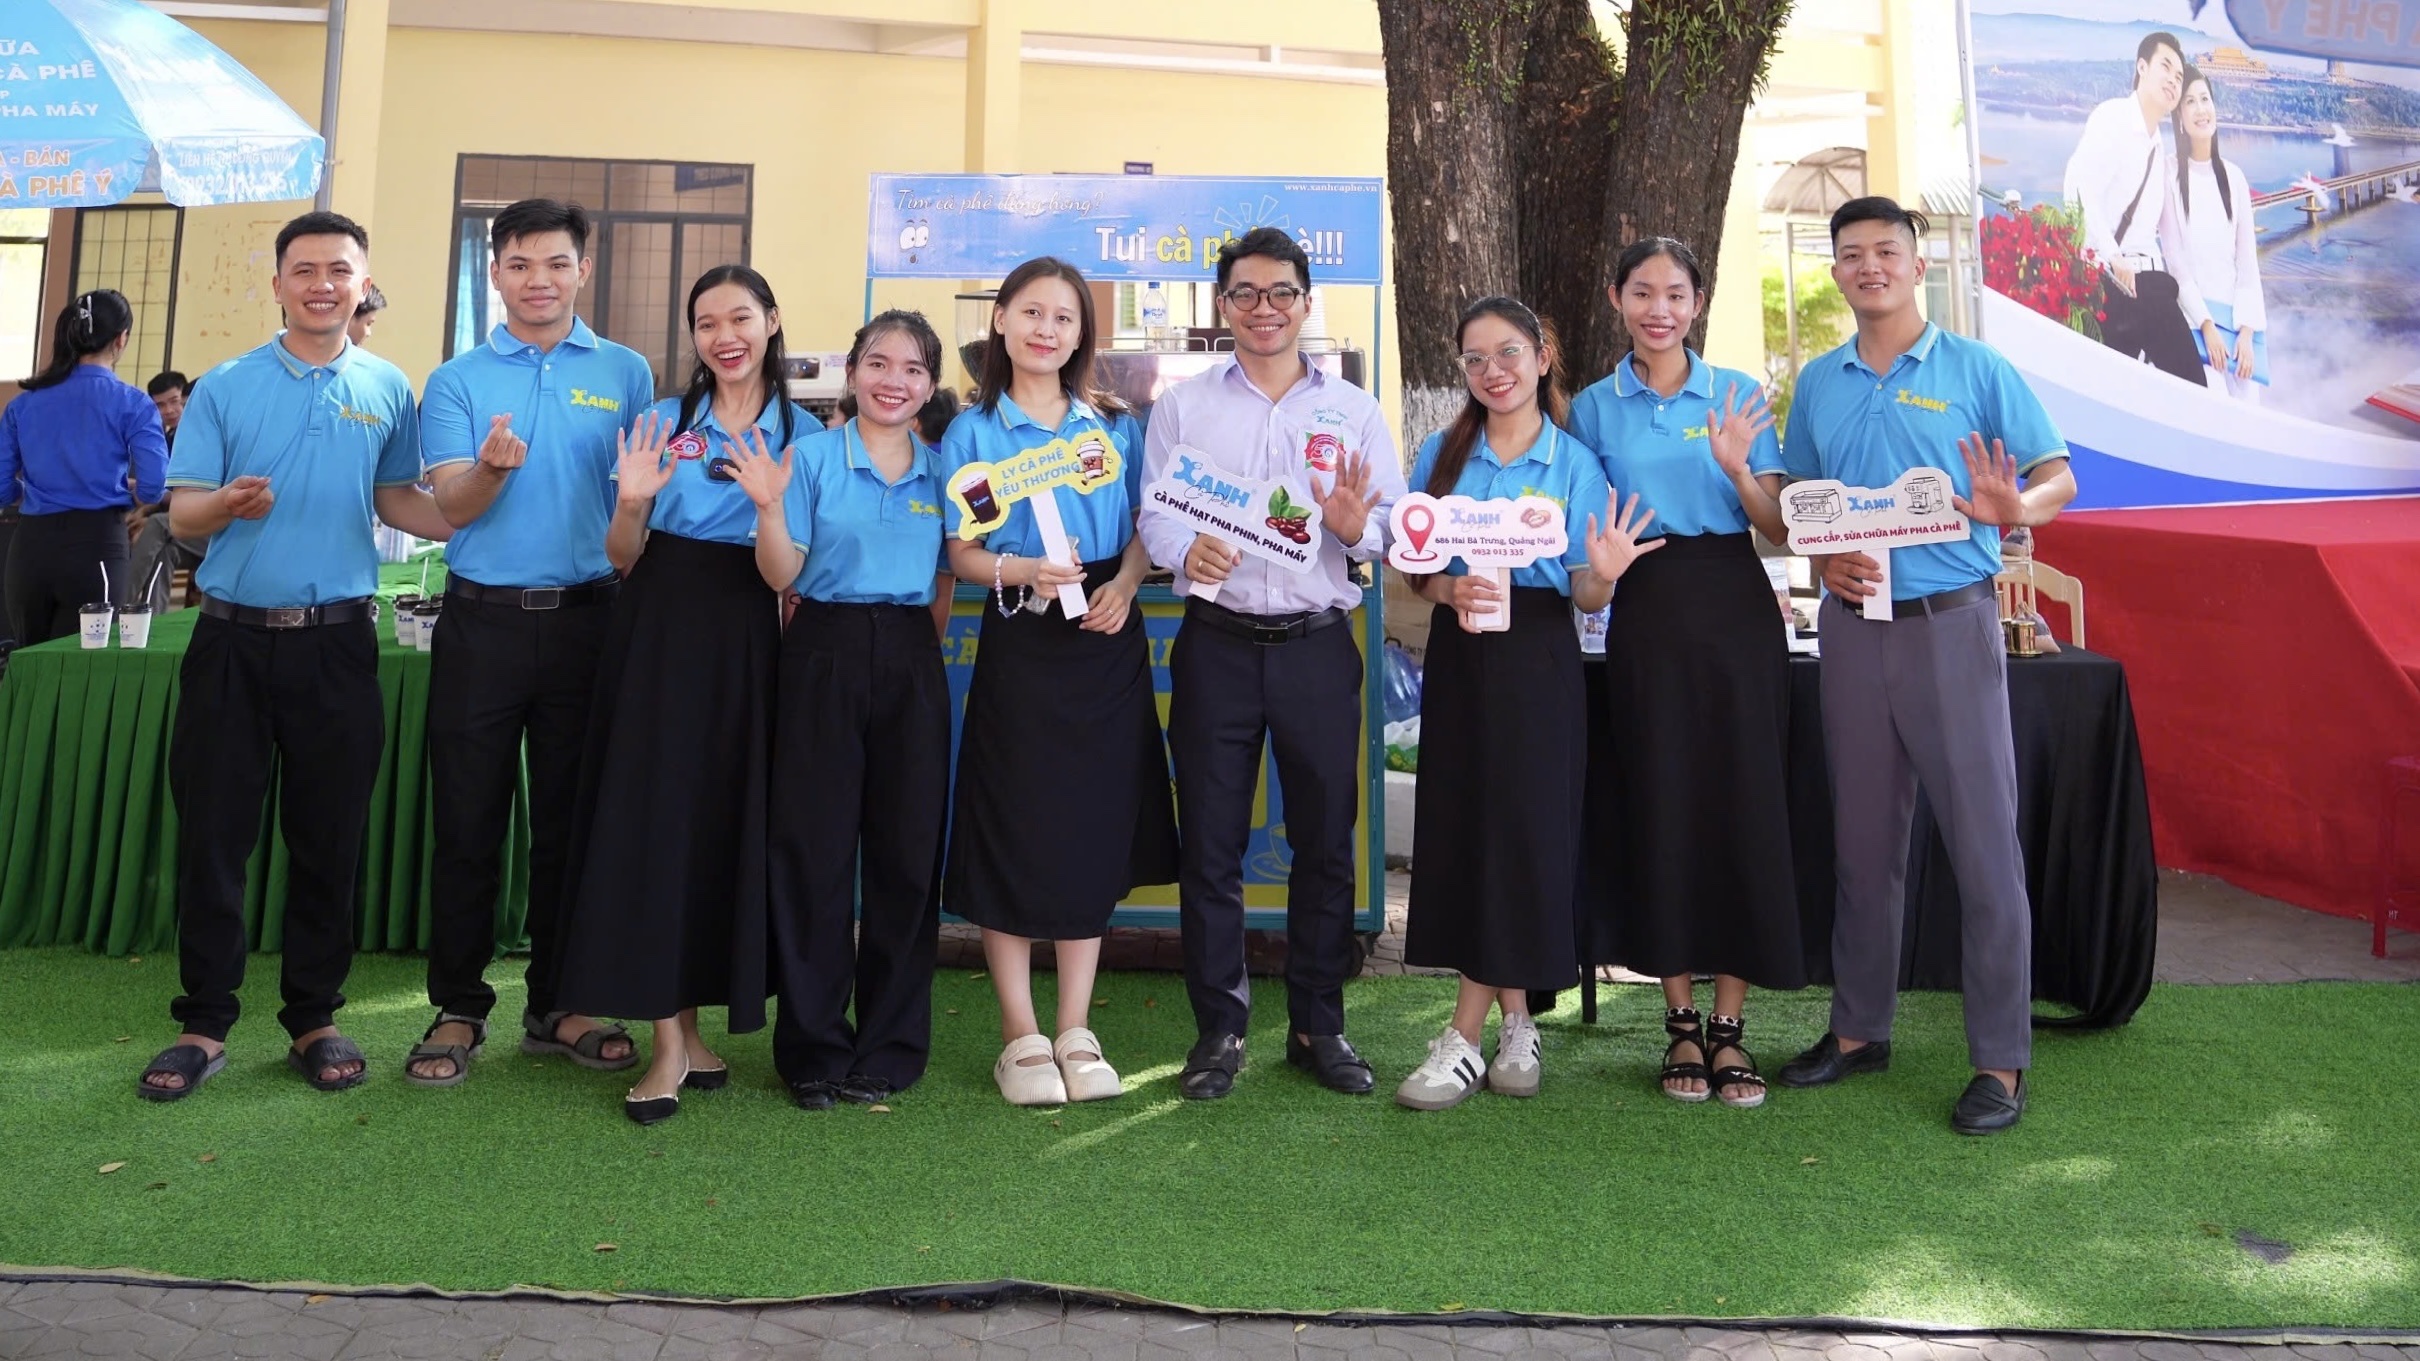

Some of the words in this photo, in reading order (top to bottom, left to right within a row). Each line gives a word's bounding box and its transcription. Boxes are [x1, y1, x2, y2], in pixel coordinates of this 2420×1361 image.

[38, 59, 96, 80] PHÊ
[0, 105, 38, 117] HA
[24, 145, 70, 167] BÁN
[28, 169, 85, 197] PHÊ
[93, 167, 113, 195] Ý
[1284, 183, 1377, 193] www.xanhcaphe.vn
[897, 188, 931, 211] Tìm
[936, 192, 955, 211] cà
[959, 191, 994, 215] phê
[1095, 225, 1148, 262] Tui
[1155, 224, 1193, 263] cà
[1001, 466, 1016, 480] LY
[1019, 457, 1037, 473] CÀ
[1040, 447, 1065, 466] PHÊ
[995, 481, 1020, 498] YÊU
[1021, 461, 1081, 489] THƯƠNG
[1172, 454, 1251, 509] XANH
[1450, 507, 1500, 524] XANH
[1847, 496, 1895, 511] XANH
[1154, 490, 1168, 505] CÀ
[1168, 497, 1190, 513] PHÊ
[1189, 506, 1211, 522] HẠT
[1210, 517, 1232, 532] PHA
[1233, 526, 1261, 546] PHIN,
[1262, 538, 1284, 554] PHA
[1284, 548, 1308, 564] MÁY
[1797, 536, 1823, 545] CUNG
[1863, 527, 1888, 539] CHỮA
[1889, 525, 1909, 537] MÁY
[1910, 526, 1929, 535] PHA
[1930, 523, 1941, 533] CÀ
[1943, 520, 1962, 532] PHÊ
